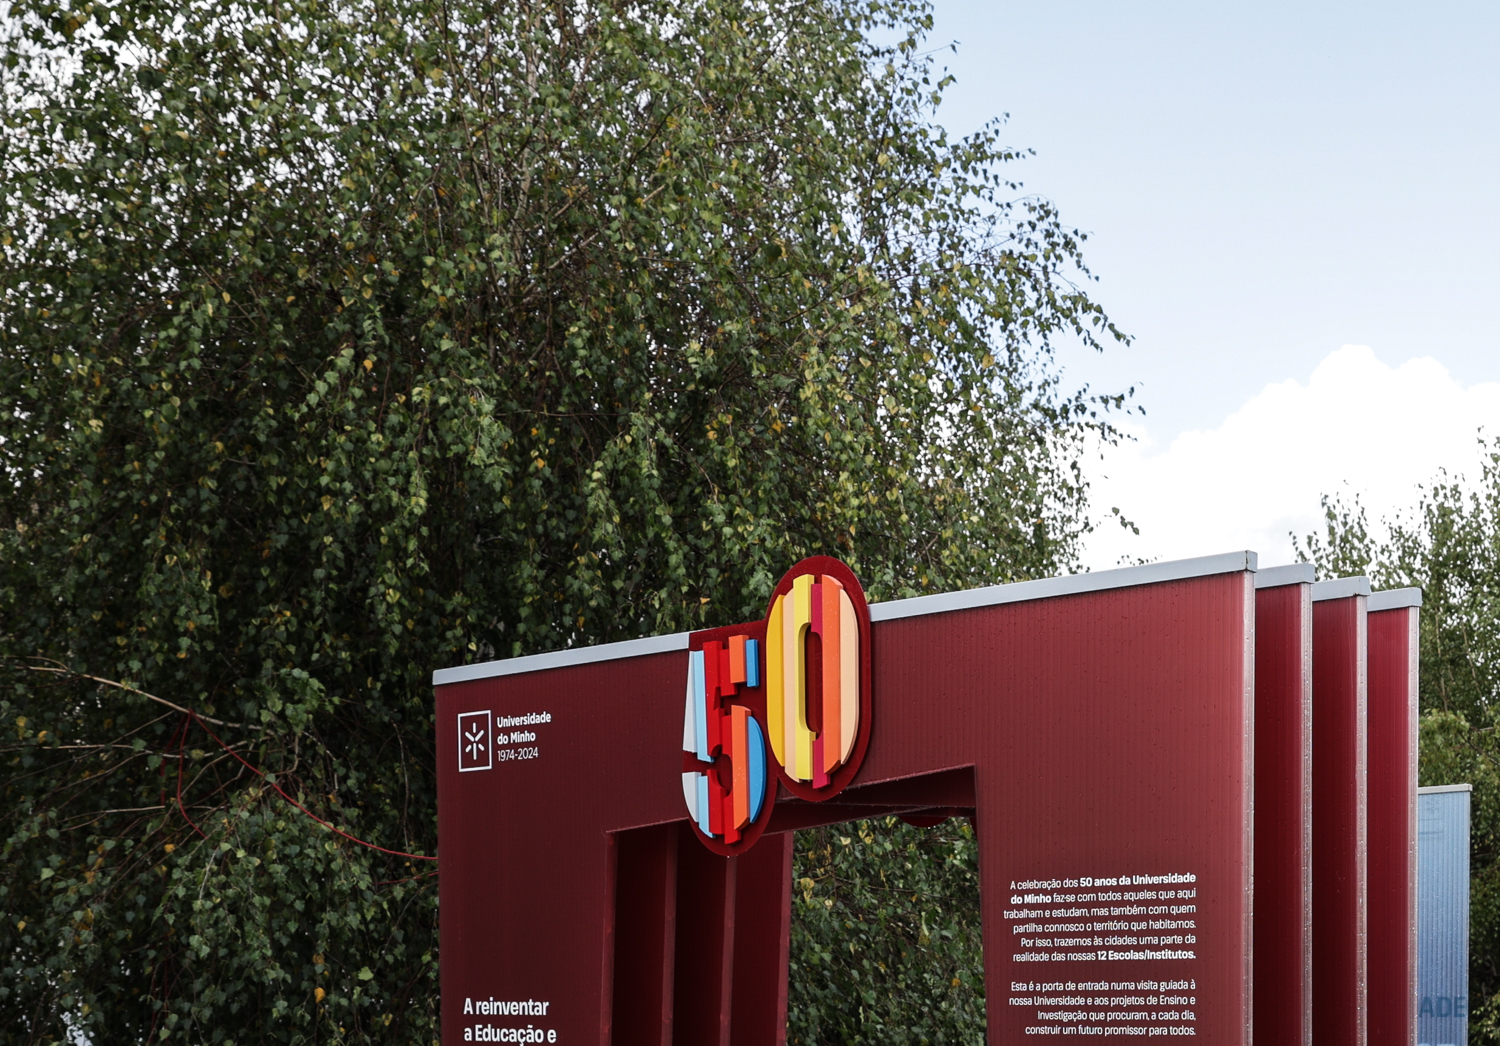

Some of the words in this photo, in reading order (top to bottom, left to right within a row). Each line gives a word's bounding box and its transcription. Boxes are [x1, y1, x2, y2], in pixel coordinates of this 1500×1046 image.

[682, 573, 859, 844] 50
[497, 712, 551, 728] Universidade
[497, 733, 509, 745] do
[510, 731, 536, 744] Minho
[498, 747, 539, 762] 1974-2024
[1010, 881, 1016, 890] A
[1017, 879, 1061, 891] celebração
[1063, 878, 1078, 888] dos
[1080, 877, 1093, 887] 50
[1094, 878, 1117, 887] anos
[1119, 875, 1131, 886] da
[1133, 872, 1196, 885] Universidade
[1011, 894, 1023, 905] do
[1024, 893, 1052, 904] Minho
[1053, 892, 1076, 903] faz-se
[1077, 894, 1096, 902] com
[1098, 891, 1122, 901] todos
[1123, 889, 1157, 902] aqueles
[1158, 890, 1175, 901] que
[1177, 888, 1196, 900] aqui
[1003, 908, 1044, 919] trabalham
[1045, 910, 1050, 918] e
[1052, 907, 1090, 918] estudam,
[1091, 908, 1109, 916] mas
[1110, 905, 1146, 916] também
[1148, 906, 1168, 915] com
[1170, 905, 1196, 916] quem
[1013, 923, 1043, 935] partilha
[1044, 923, 1085, 932] connosco
[1086, 923, 1092, 931] o
[1093, 920, 1129, 931] território
[1130, 922, 1148, 932] que
[1149, 919, 1196, 930] habitamos.
[1021, 938, 1034, 947] Por
[1036, 937, 1053, 947] isso,
[1054, 938, 1092, 947] trazemos
[1093, 936, 1103, 946] às
[1104, 935, 1138, 946] cidades
[1139, 936, 1158, 945] uma
[1160, 935, 1183, 946] parte
[1185, 934, 1196, 944] da
[1013, 952, 1050, 962] realidade
[1051, 951, 1066, 961] das
[1067, 953, 1096, 961] nossas
[1097, 951, 1107, 960] 12
[1108, 950, 1196, 960] Escolas/Institutos.
[1011, 982, 1027, 992] Esta
[1029, 981, 1034, 991] é
[1035, 983, 1041, 991] a
[1042, 982, 1064, 993] porta
[1065, 981, 1076, 991] de
[1078, 980, 1109, 991] entrada
[1111, 982, 1135, 990] numa
[1136, 980, 1158, 990] visita
[1159, 979, 1188, 992] guiada
[1190, 979, 1196, 990] à
[464, 998, 474, 1015] A
[476, 996, 549, 1016] reinventar
[1009, 998, 1033, 1006] nossa
[1034, 995, 1086, 1006] Universidade
[1087, 997, 1093, 1006] e
[1094, 997, 1109, 1006] aos
[1111, 995, 1145, 1008] projetos
[1146, 995, 1158, 1005] de
[1160, 995, 1188, 1005] Ensino
[1190, 996, 1196, 1005] e
[1038, 1010, 1088, 1022] Investigação
[1089, 1012, 1105, 1022] que
[1107, 1012, 1150, 1022] procuram,
[1151, 1012, 1156, 1020] a
[1158, 1010, 1179, 1020] cada
[1181, 1010, 1196, 1021] dia,
[464, 1028, 472, 1041] a
[475, 1024, 544, 1046] Educação
[547, 1029, 557, 1044] e
[1025, 1025, 1061, 1035] construir
[1062, 1027, 1077, 1035] um
[1078, 1025, 1103, 1035] futuro
[1104, 1025, 1148, 1037] promissor
[1149, 1027, 1168, 1037] para
[1169, 1025, 1196, 1036] todos.
